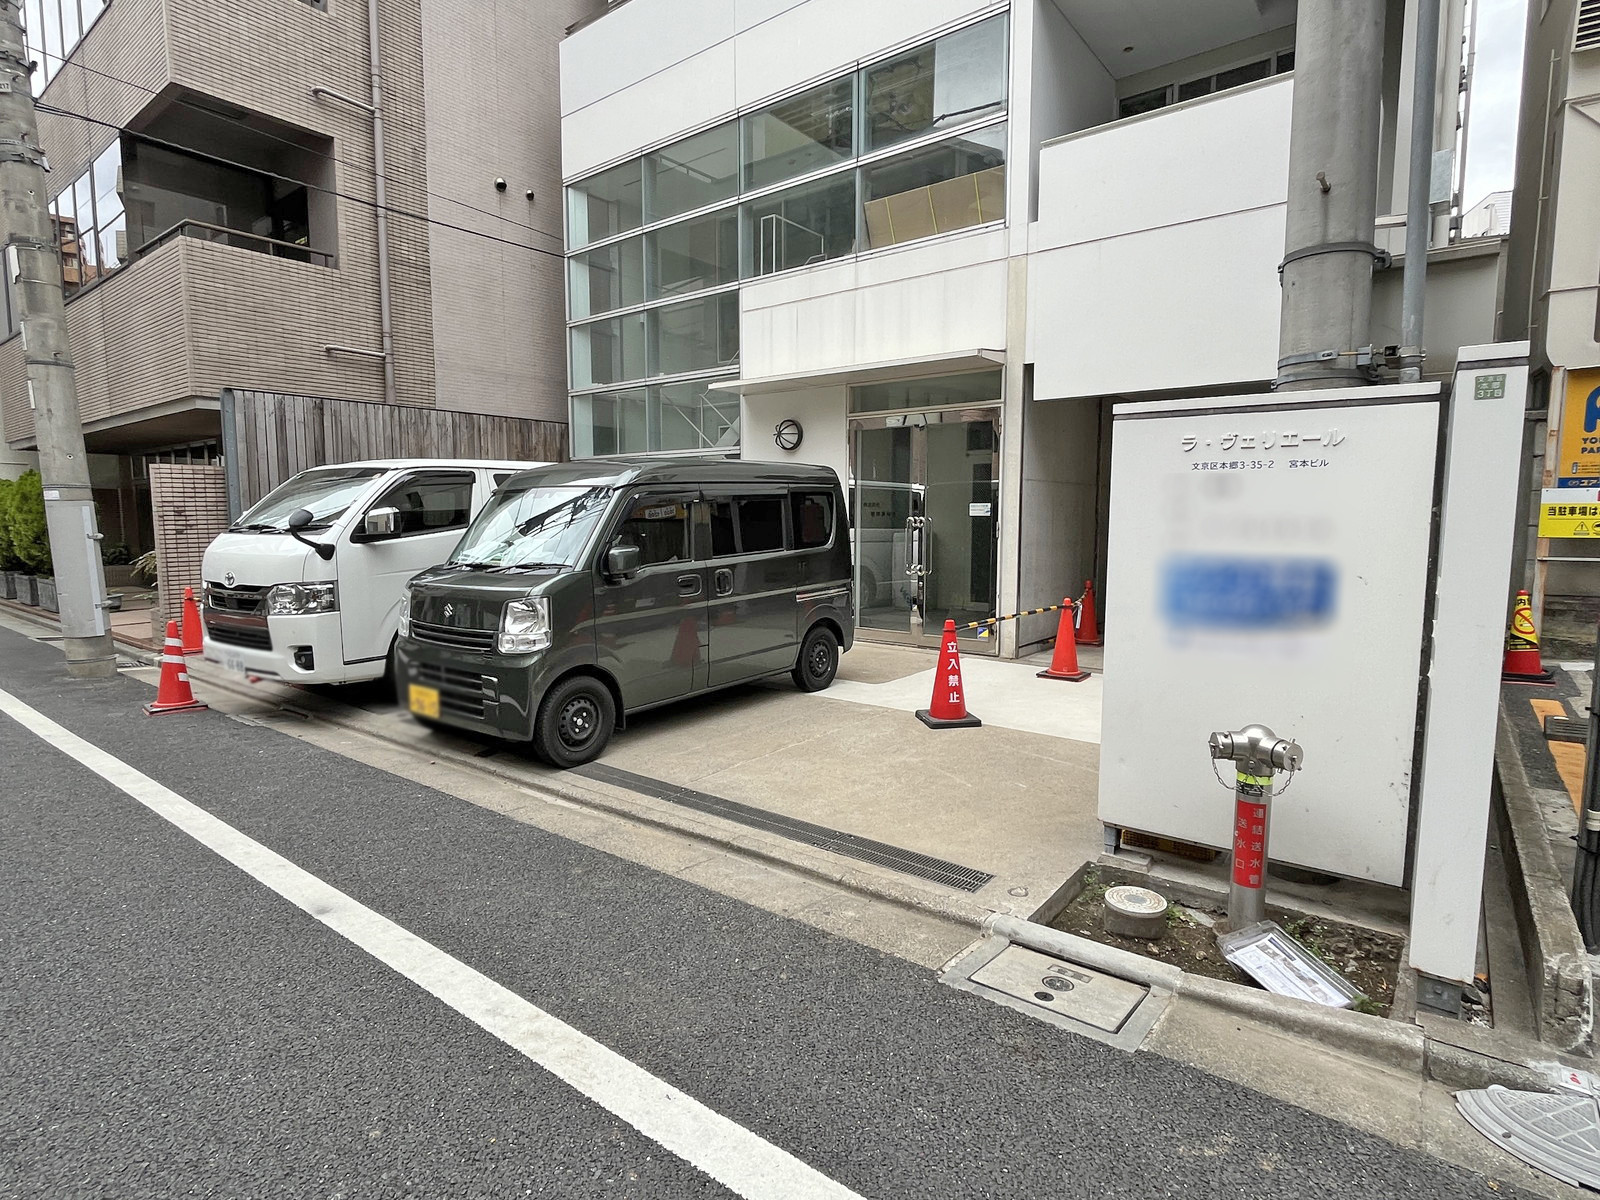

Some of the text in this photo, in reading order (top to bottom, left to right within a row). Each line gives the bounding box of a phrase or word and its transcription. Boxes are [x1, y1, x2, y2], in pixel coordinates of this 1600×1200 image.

[1477, 389, 1502, 398] 3丁目
[1181, 428, 1346, 453] ラ・ヴェリエール
[1192, 459, 1330, 471] 文京区本郷3-35-2 宮本ビル
[947, 641, 960, 703] 立入禁止
[1235, 817, 1248, 870] 送水口
[1249, 808, 1264, 885] 連結送水管
